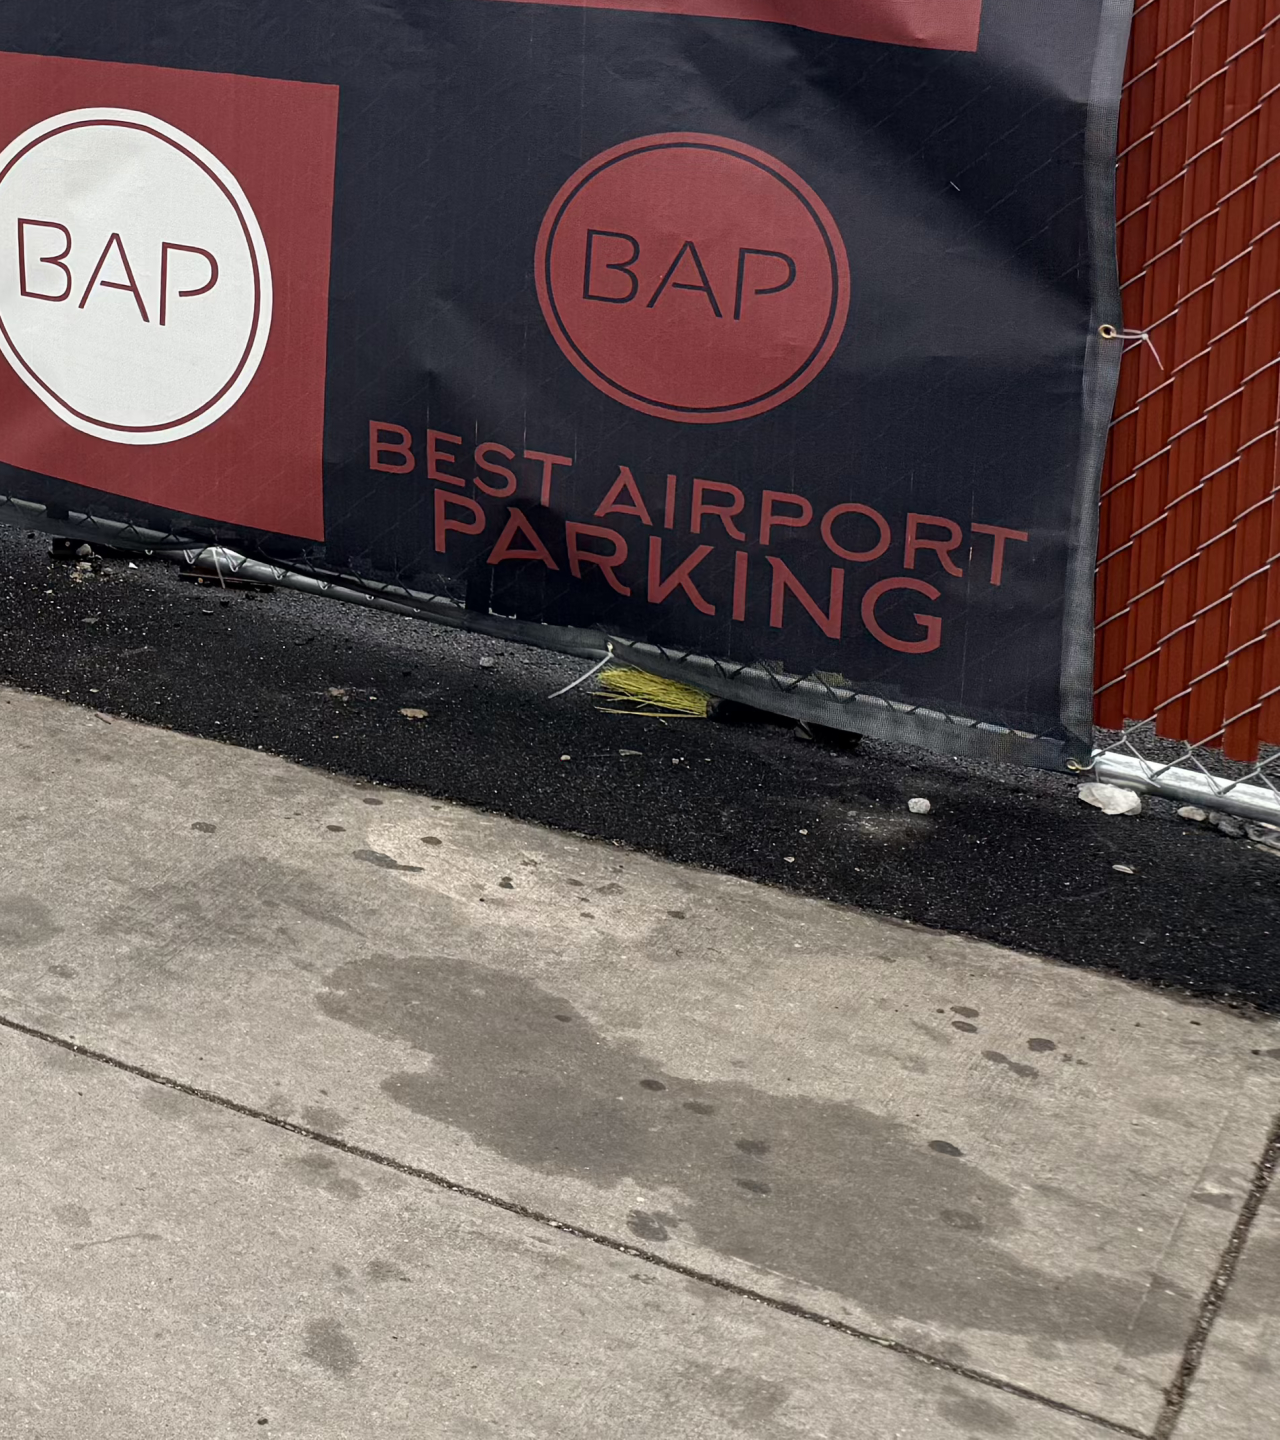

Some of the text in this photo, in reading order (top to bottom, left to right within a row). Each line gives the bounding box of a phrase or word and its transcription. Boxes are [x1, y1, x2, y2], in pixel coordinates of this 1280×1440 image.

[17, 217, 220, 327] BAP
[581, 228, 797, 322] BAP
[367, 420, 1029, 586] BEST AIRPORT
[434, 488, 943, 654] PARKING
